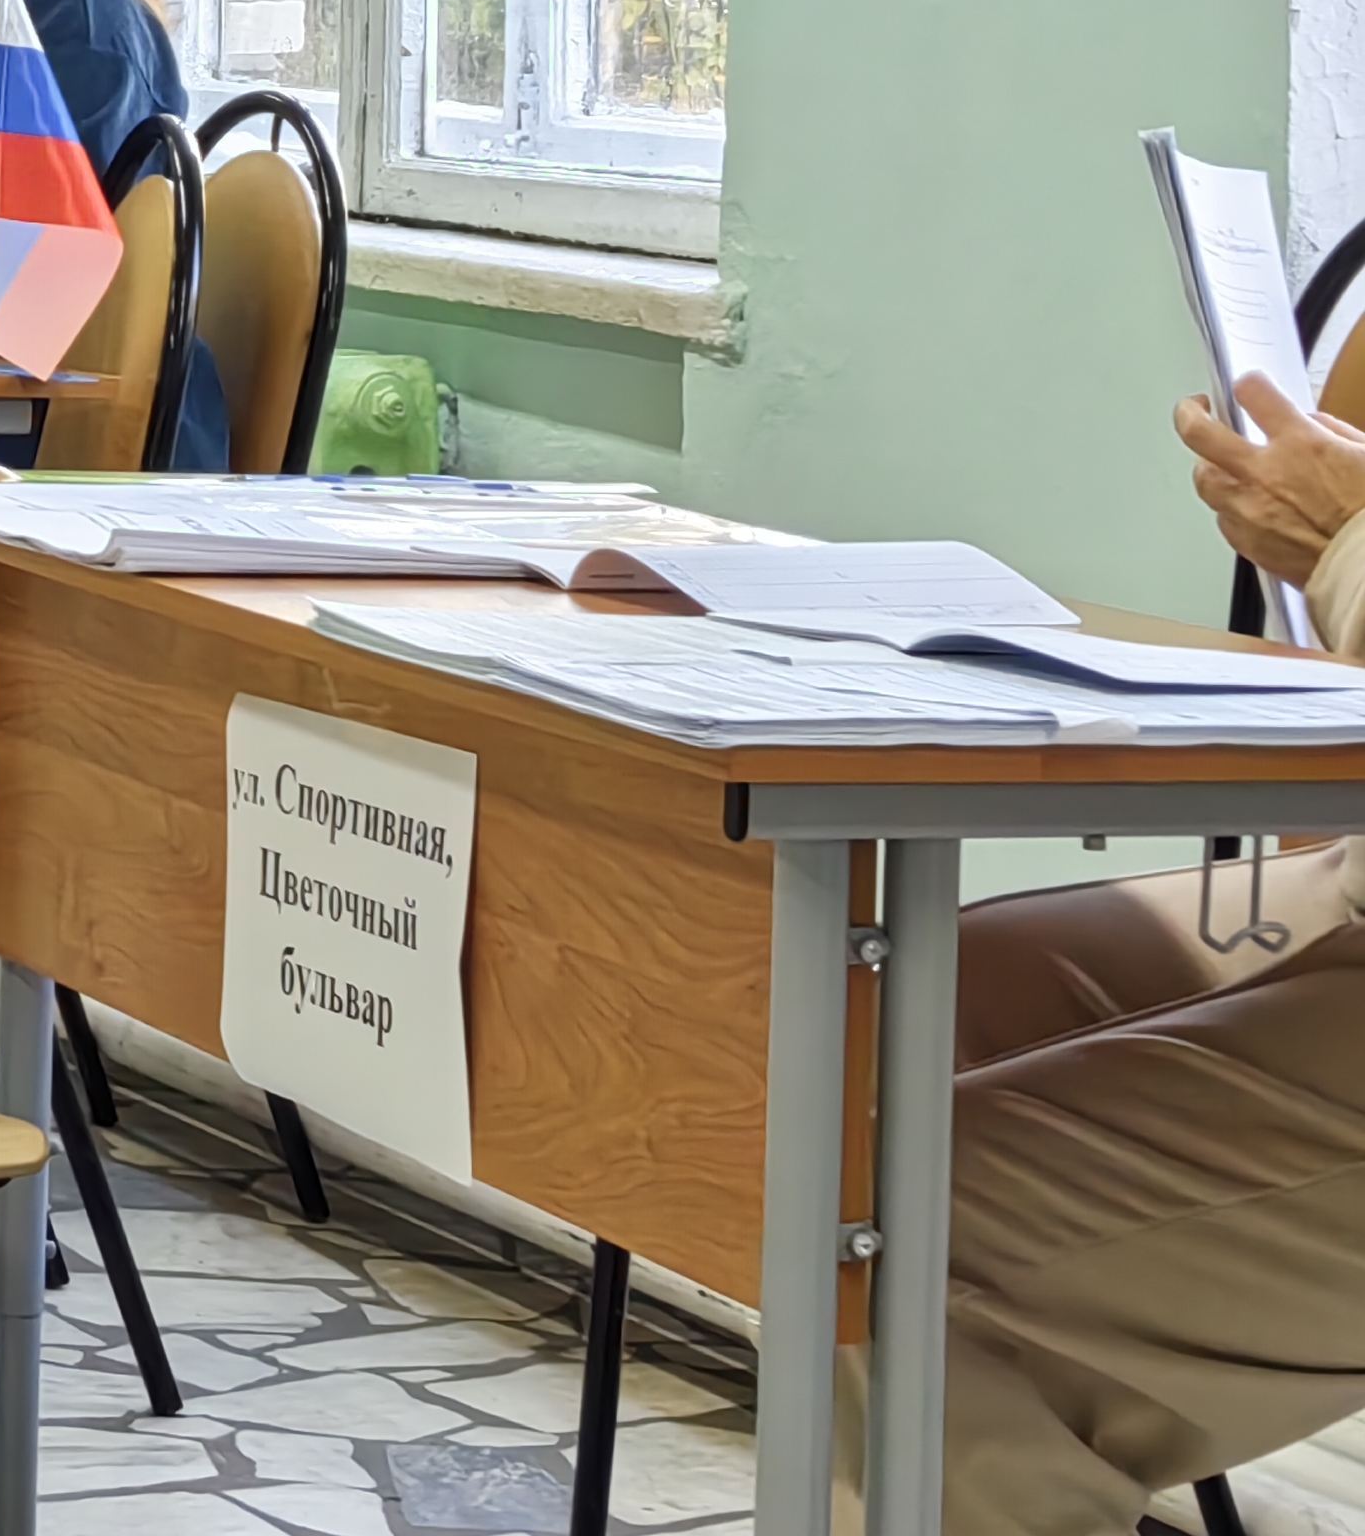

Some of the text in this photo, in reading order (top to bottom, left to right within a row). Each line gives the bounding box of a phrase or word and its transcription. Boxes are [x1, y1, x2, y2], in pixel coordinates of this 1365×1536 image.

[232, 763, 454, 879] ул. Спортивная,
[259, 845, 418, 951] Цветочный
[280, 946, 394, 1048] бульвар
